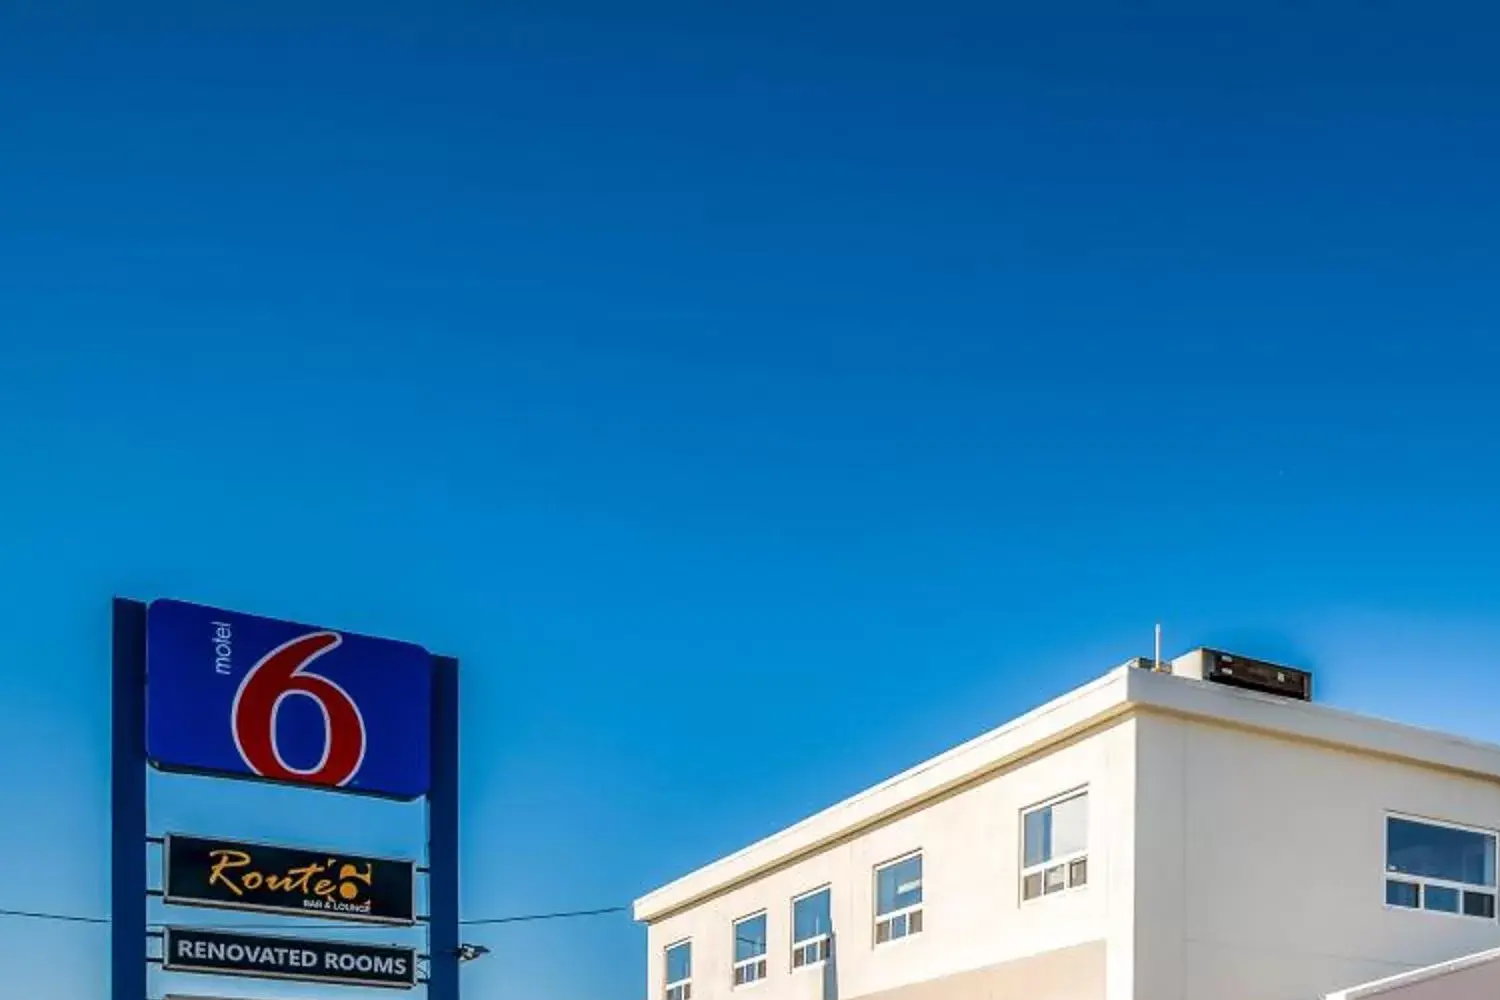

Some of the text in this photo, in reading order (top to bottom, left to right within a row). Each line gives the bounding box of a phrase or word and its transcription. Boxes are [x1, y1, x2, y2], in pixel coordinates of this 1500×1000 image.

[211, 621, 232, 675] motel
[231, 630, 367, 787] 6
[177, 938, 407, 975] RENOVATED ROOMS
